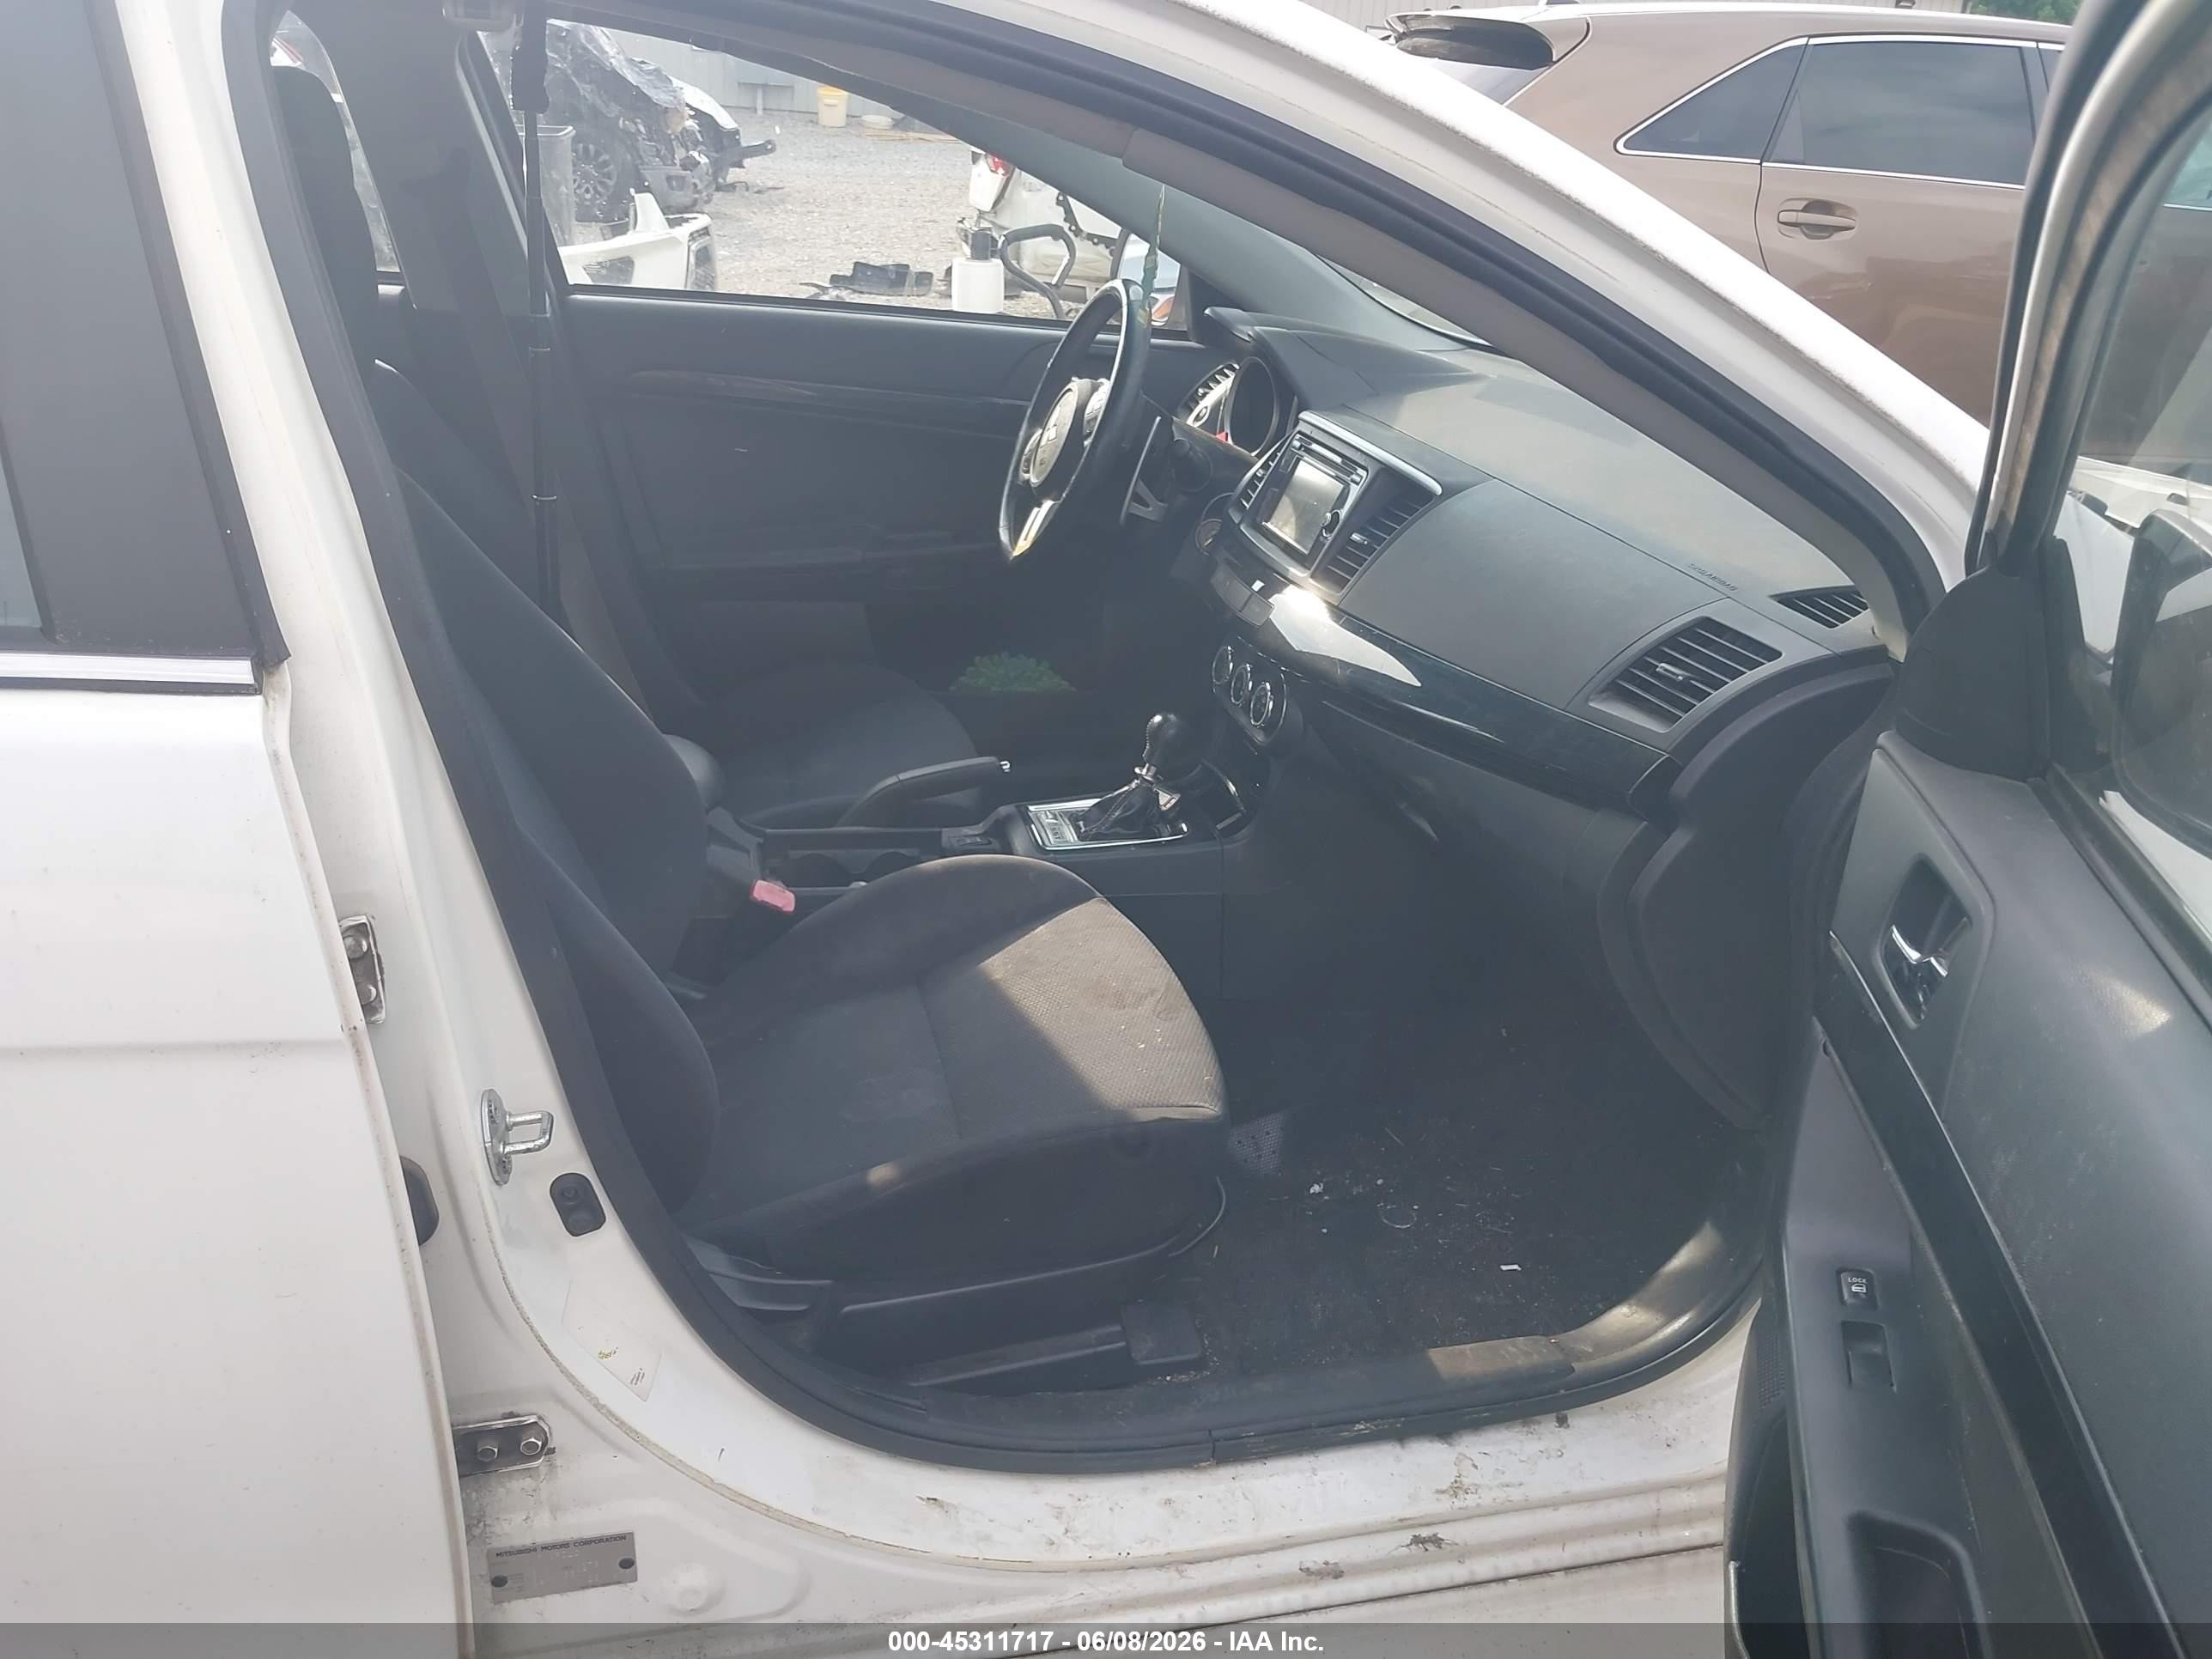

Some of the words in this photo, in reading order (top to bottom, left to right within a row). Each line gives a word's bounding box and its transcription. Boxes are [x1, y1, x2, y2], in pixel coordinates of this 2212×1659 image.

[495, 1547, 538, 1558] MITSUBISHI
[541, 1542, 570, 1553] MOTORS
[573, 1534, 627, 1548] CORPORATION
